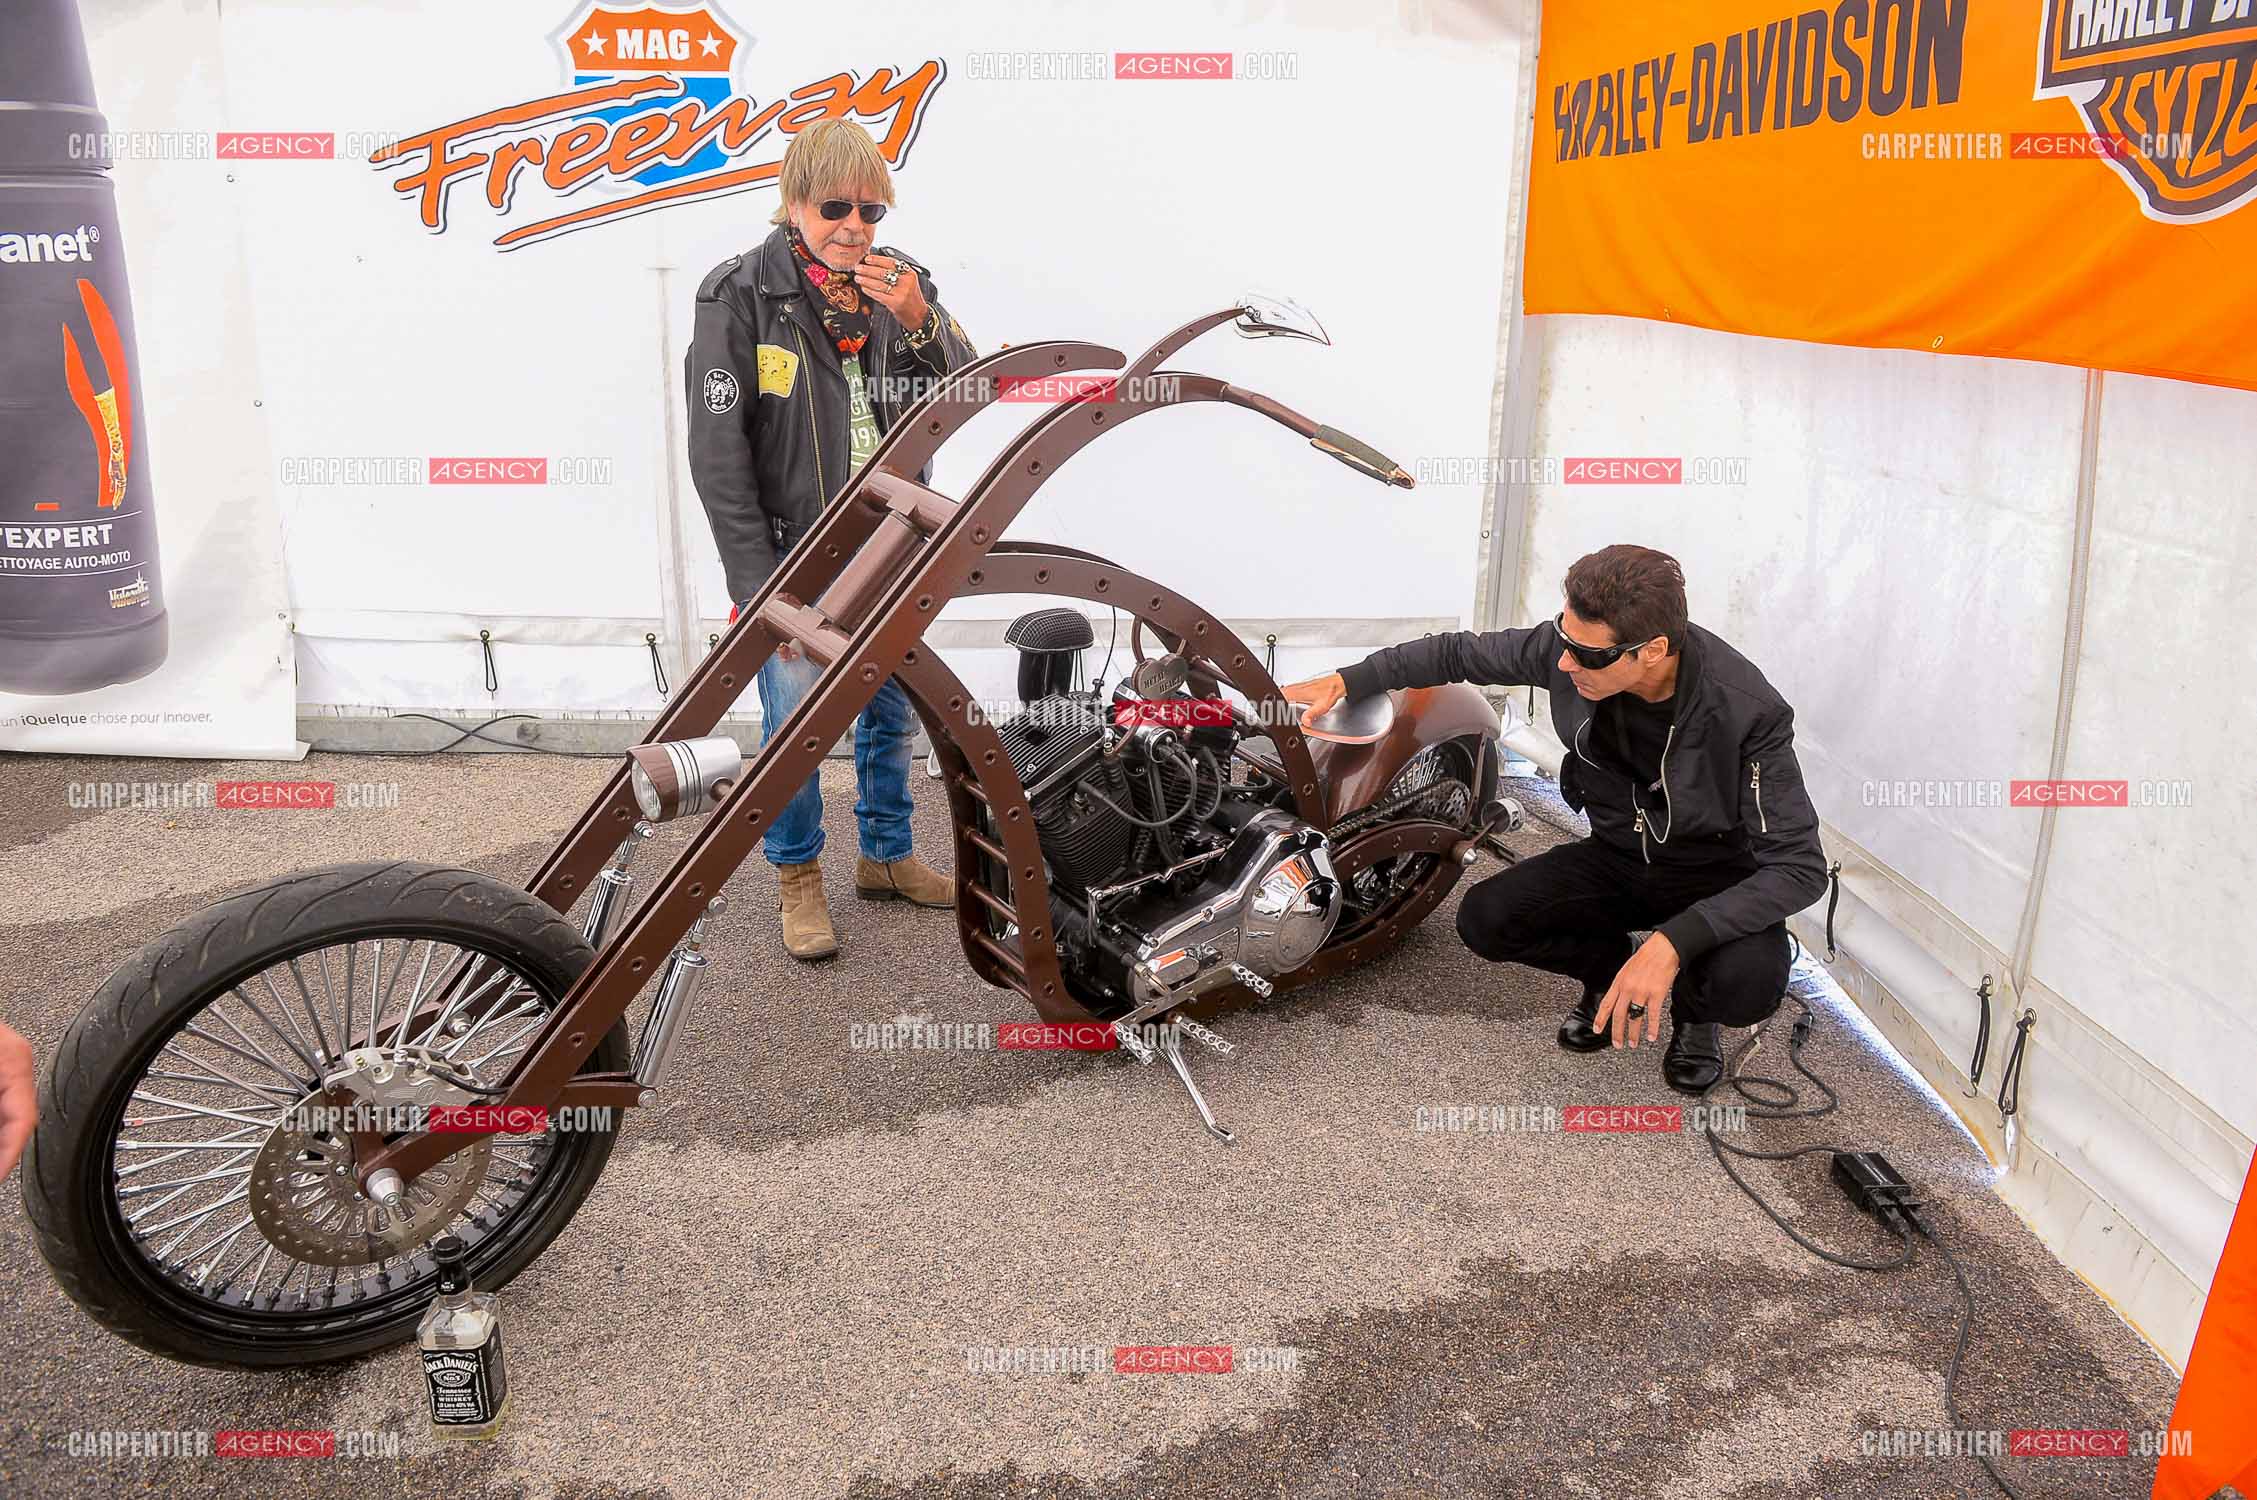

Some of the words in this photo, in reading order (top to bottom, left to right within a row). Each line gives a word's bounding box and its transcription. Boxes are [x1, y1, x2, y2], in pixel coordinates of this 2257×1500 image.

[616, 28, 690, 60] MAG
[1553, 0, 1968, 164] HARLEY-DAVIDSON
[369, 60, 942, 228] Freeway
[0, 556, 62, 570] TTOYAGE
[64, 550, 131, 569] AUTO-MOTO
[21, 713, 88, 727] iQuelque
[90, 711, 128, 725] chose
[130, 713, 160, 726] pour
[423, 1359, 444, 1374] JACK
